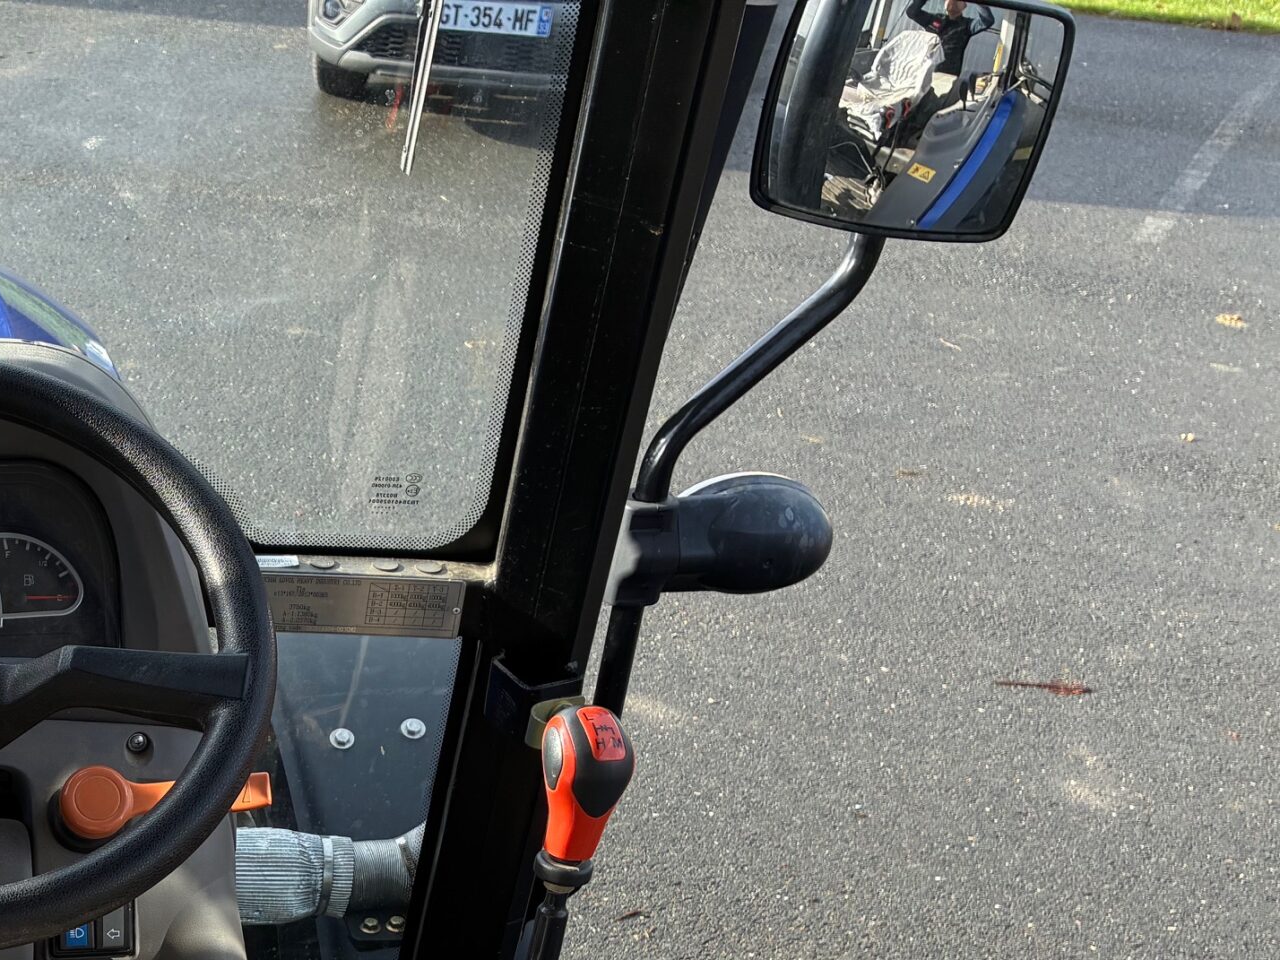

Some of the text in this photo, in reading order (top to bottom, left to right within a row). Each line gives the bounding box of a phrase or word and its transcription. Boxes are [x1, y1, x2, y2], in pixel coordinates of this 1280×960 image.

[5, 550, 11, 559] F
[583, 712, 594, 721] L
[595, 738, 606, 750] H
